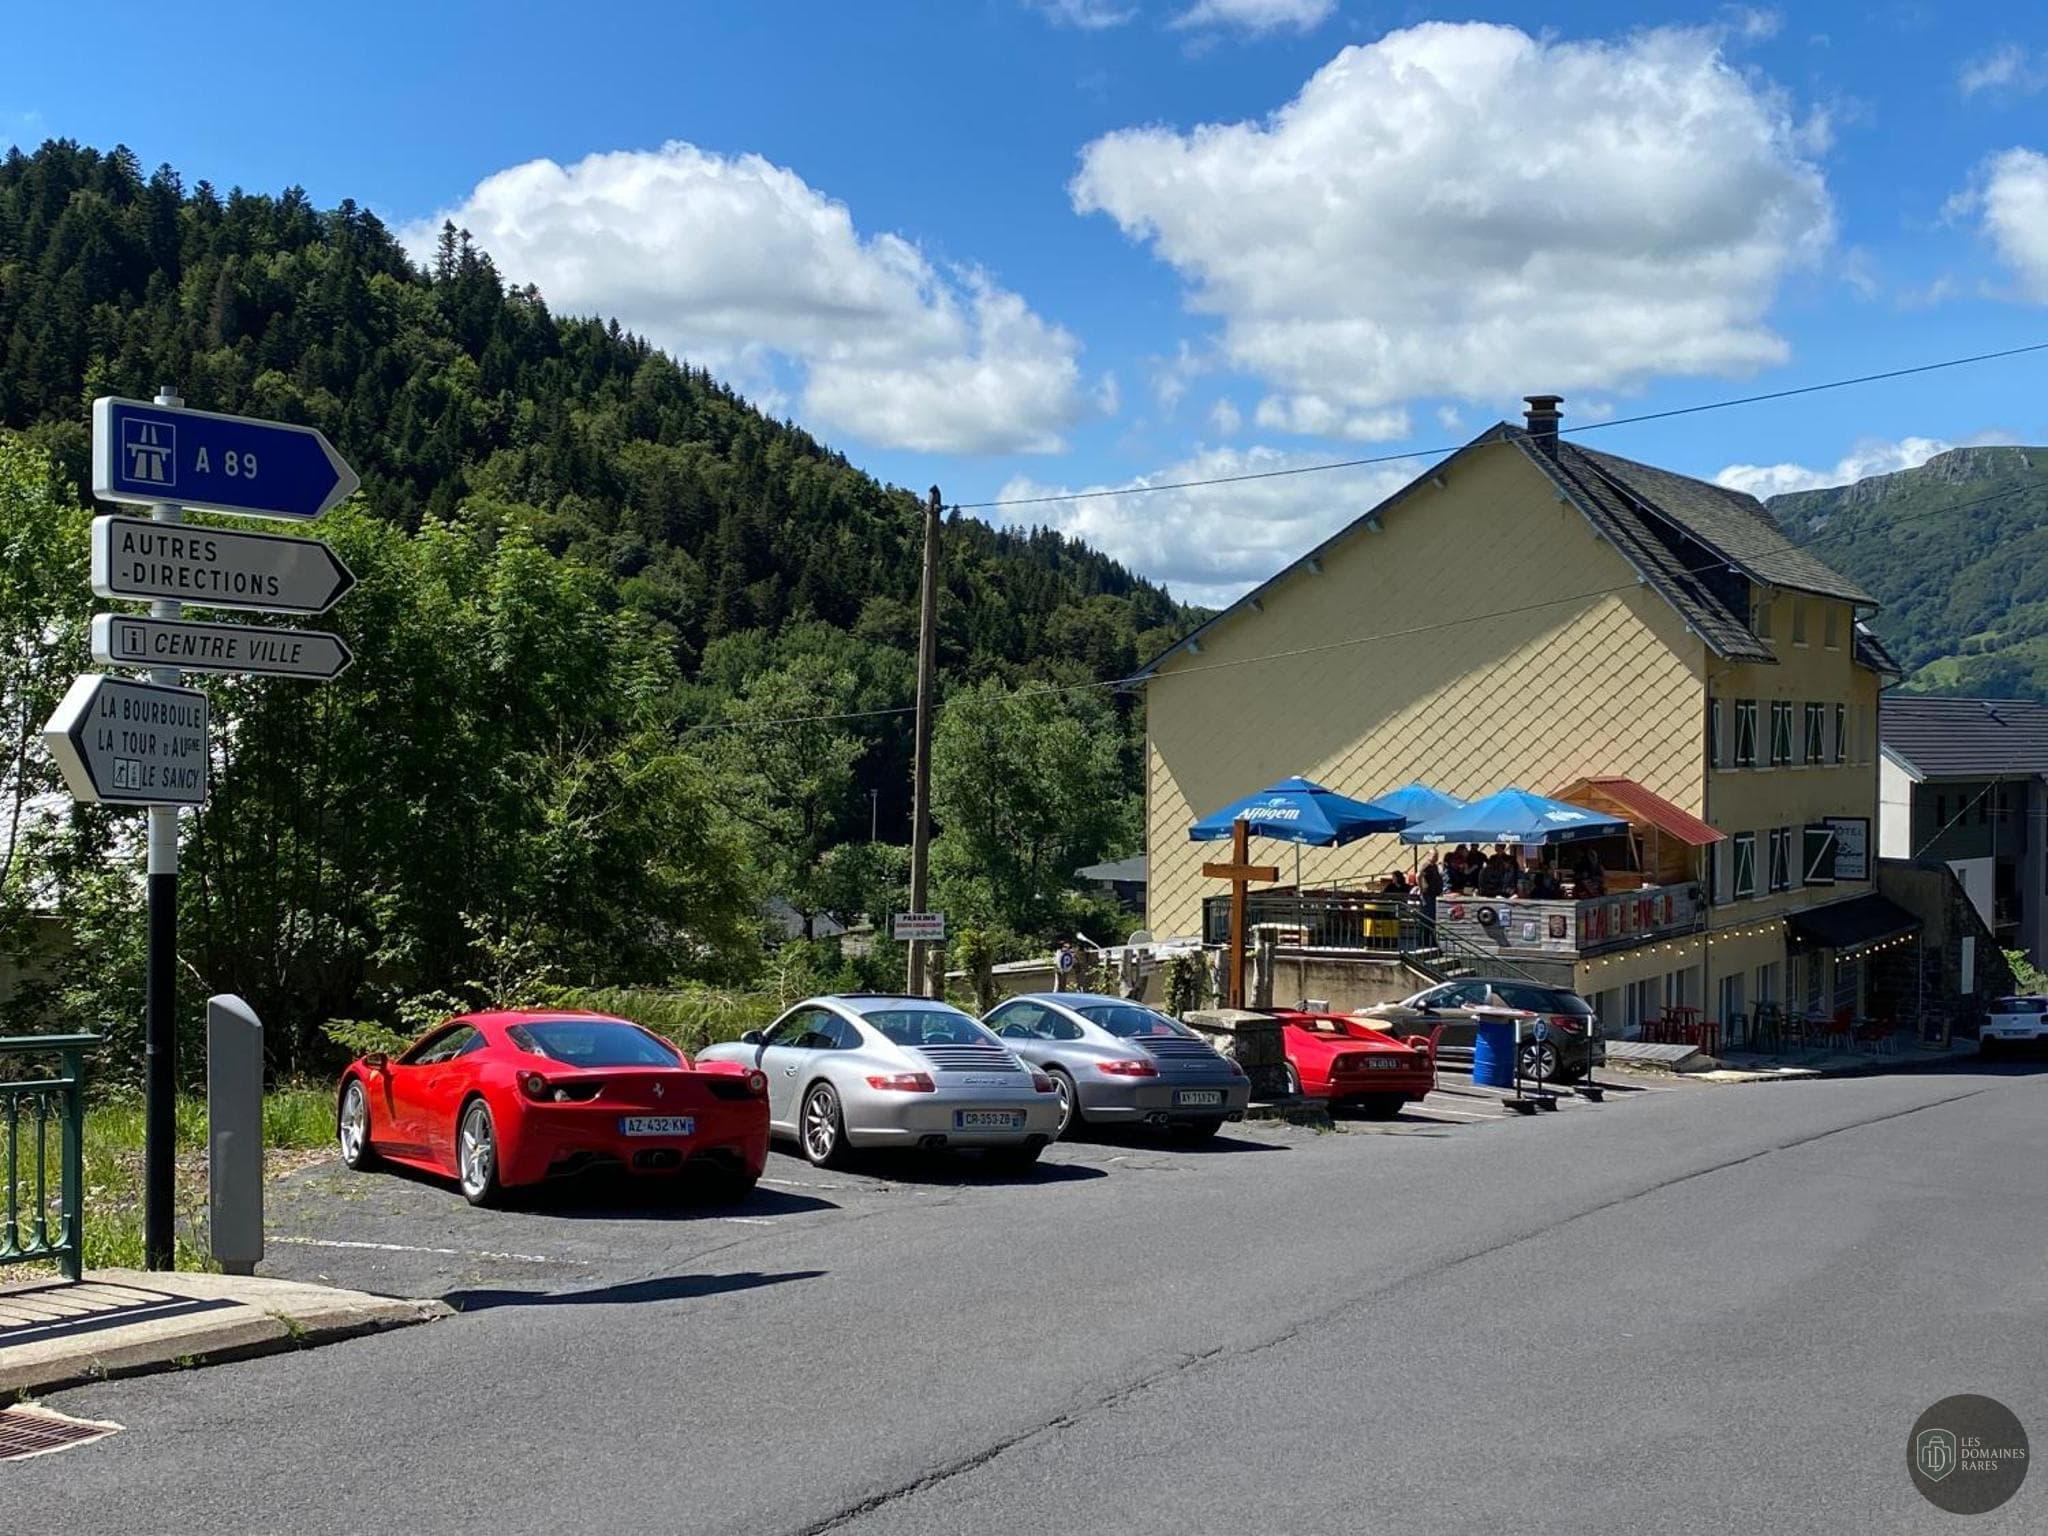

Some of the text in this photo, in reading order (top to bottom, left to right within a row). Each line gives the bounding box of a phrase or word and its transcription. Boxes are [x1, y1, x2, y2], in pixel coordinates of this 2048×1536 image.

[195, 447, 258, 479] A 89
[122, 532, 217, 562] AUTRES
[154, 633, 237, 659] CENTRE
[250, 640, 302, 663] VILLE
[101, 696, 200, 729] LA BOURBOULE
[98, 728, 114, 751] LA
[122, 731, 156, 755] TOUR
[142, 765, 199, 789] LE SANCY
